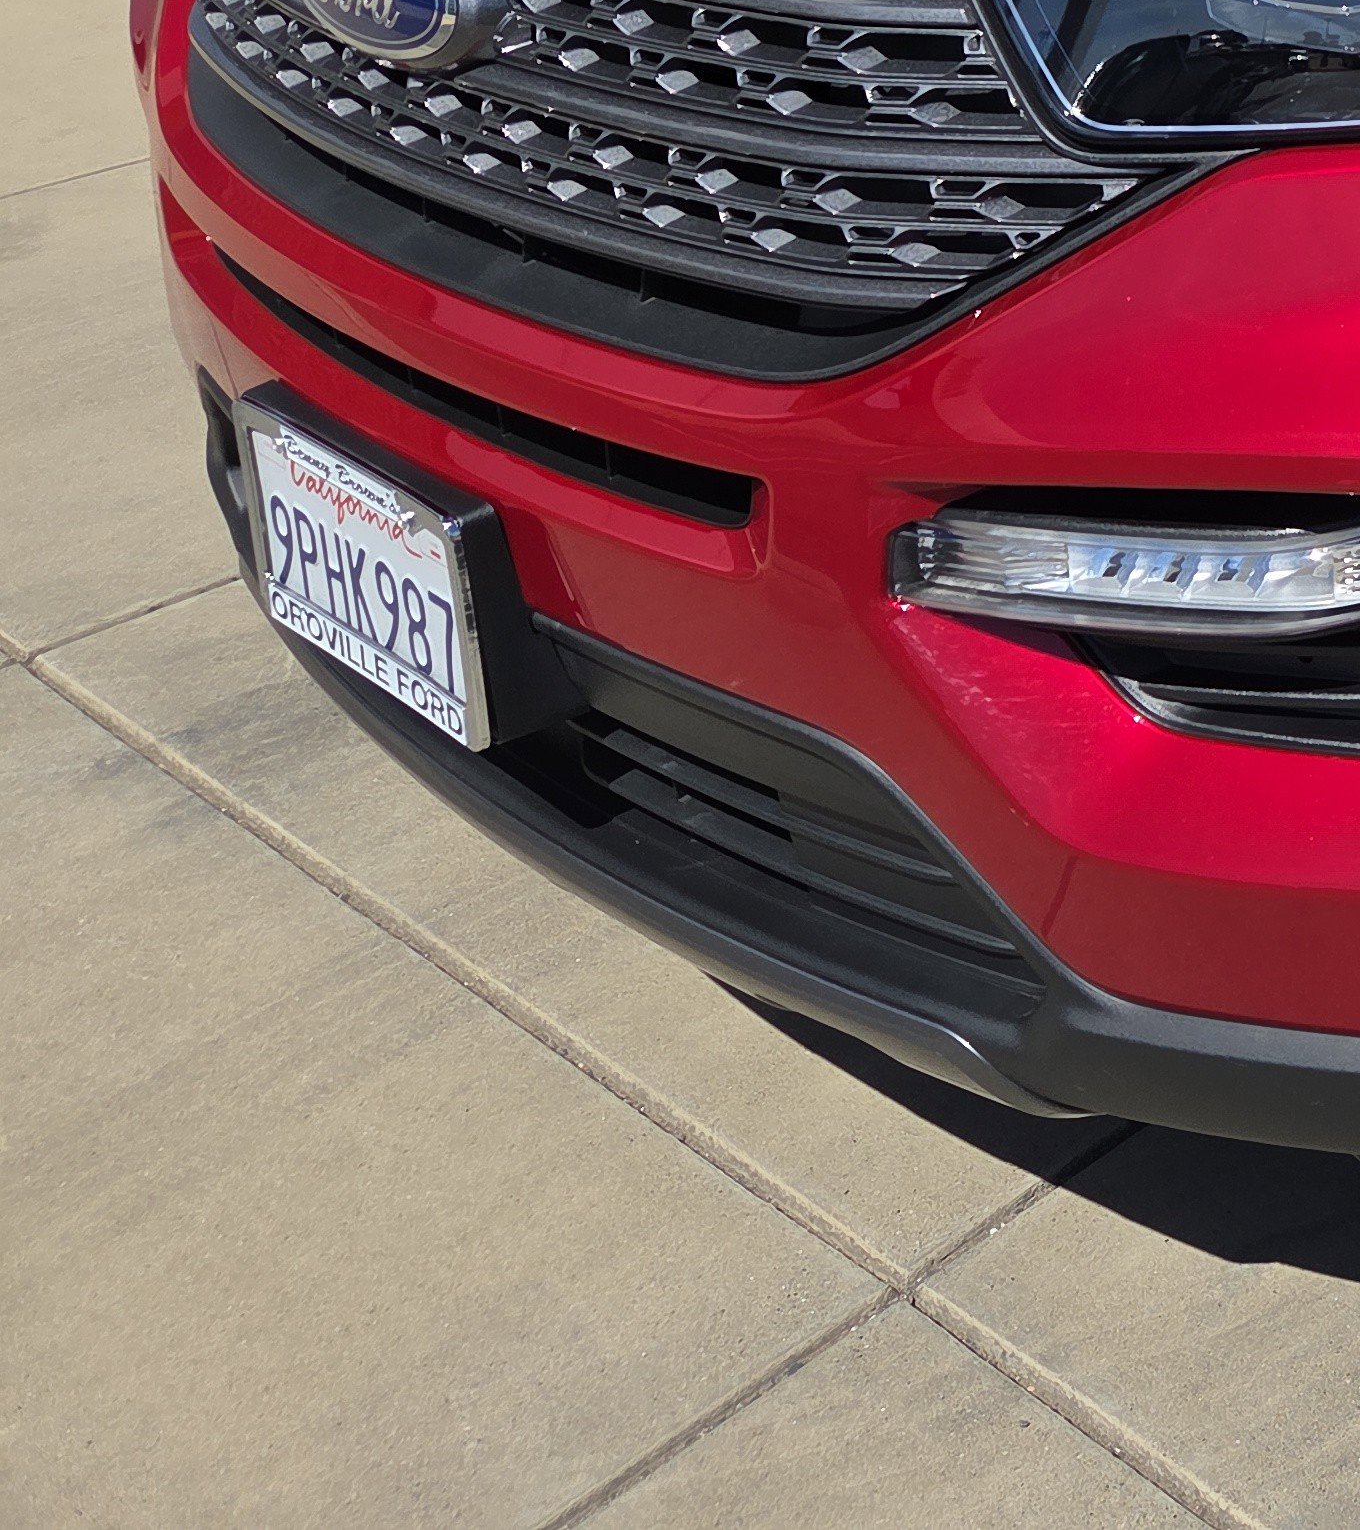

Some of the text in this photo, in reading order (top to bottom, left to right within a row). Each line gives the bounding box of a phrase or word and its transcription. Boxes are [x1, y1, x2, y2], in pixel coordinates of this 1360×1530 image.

[288, 459, 423, 559] California
[269, 493, 456, 694] 9PHK987
[270, 589, 464, 737] OROVILLE FORD
